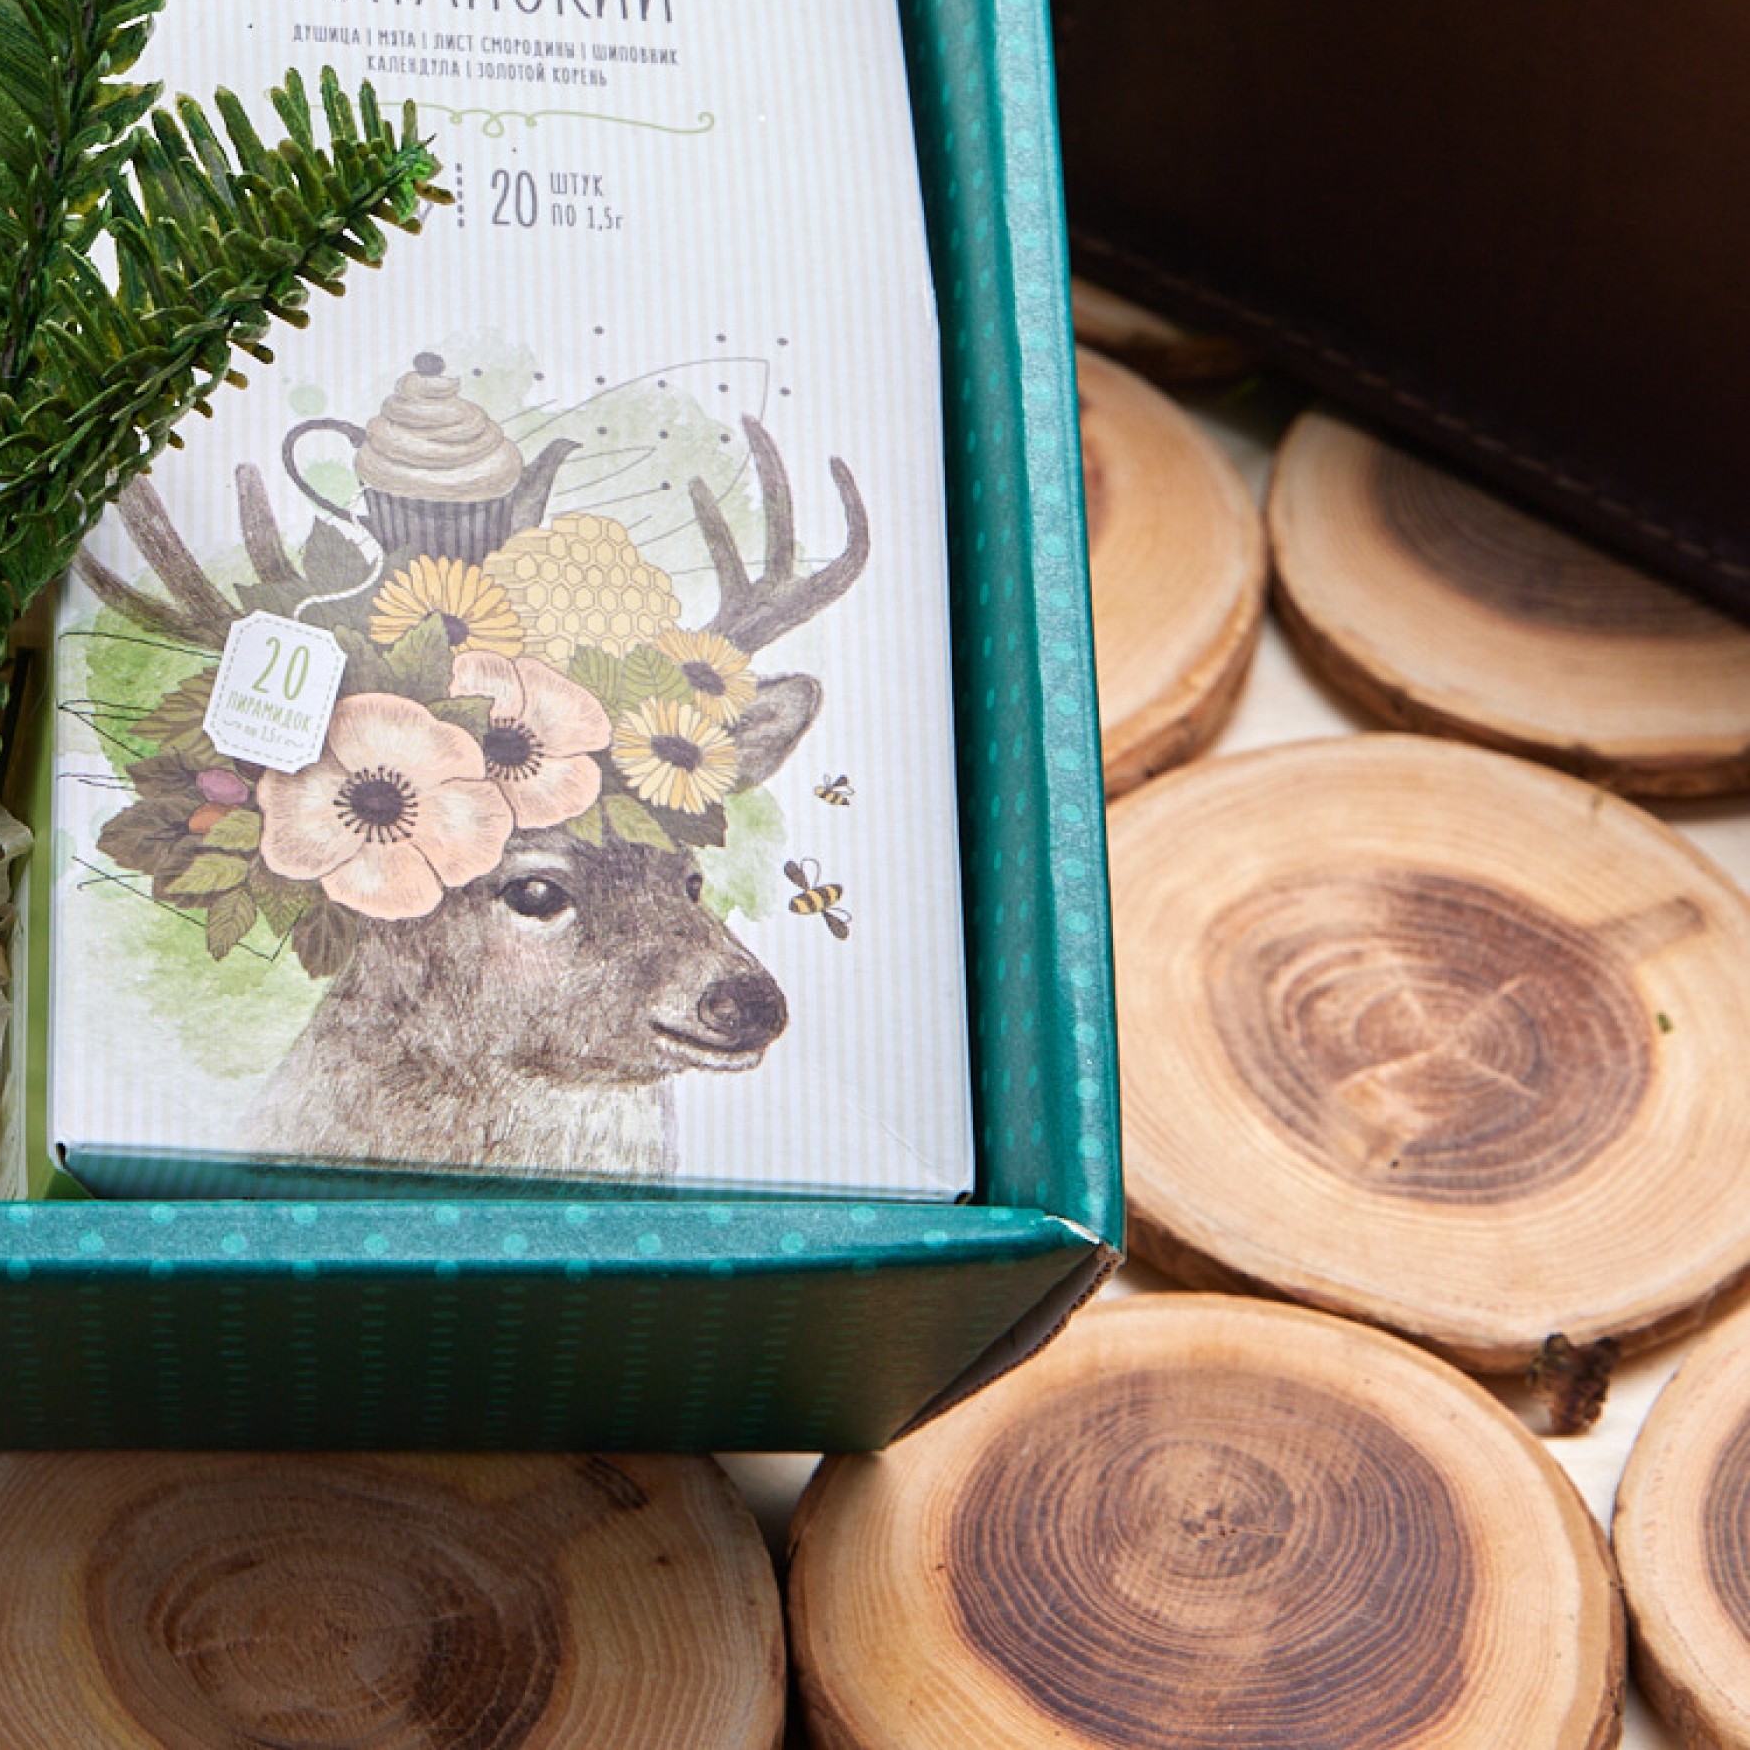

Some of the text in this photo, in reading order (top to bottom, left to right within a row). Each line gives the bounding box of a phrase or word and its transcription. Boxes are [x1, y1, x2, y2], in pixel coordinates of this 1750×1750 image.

[292, 23, 679, 66] ДУШИЦА МЯТА ЛИСТ СМОРОДИНЫ ШИПОВНИК
[366, 56, 608, 87] КАЛЕНДУЛА ЗОЛОТОЙ КОРЕНЬ
[489, 168, 538, 229] 20
[549, 169, 606, 198] ШТУК
[551, 202, 578, 227] ПО
[251, 636, 311, 701] 20
[226, 690, 312, 734] ПИРАМИДОК
